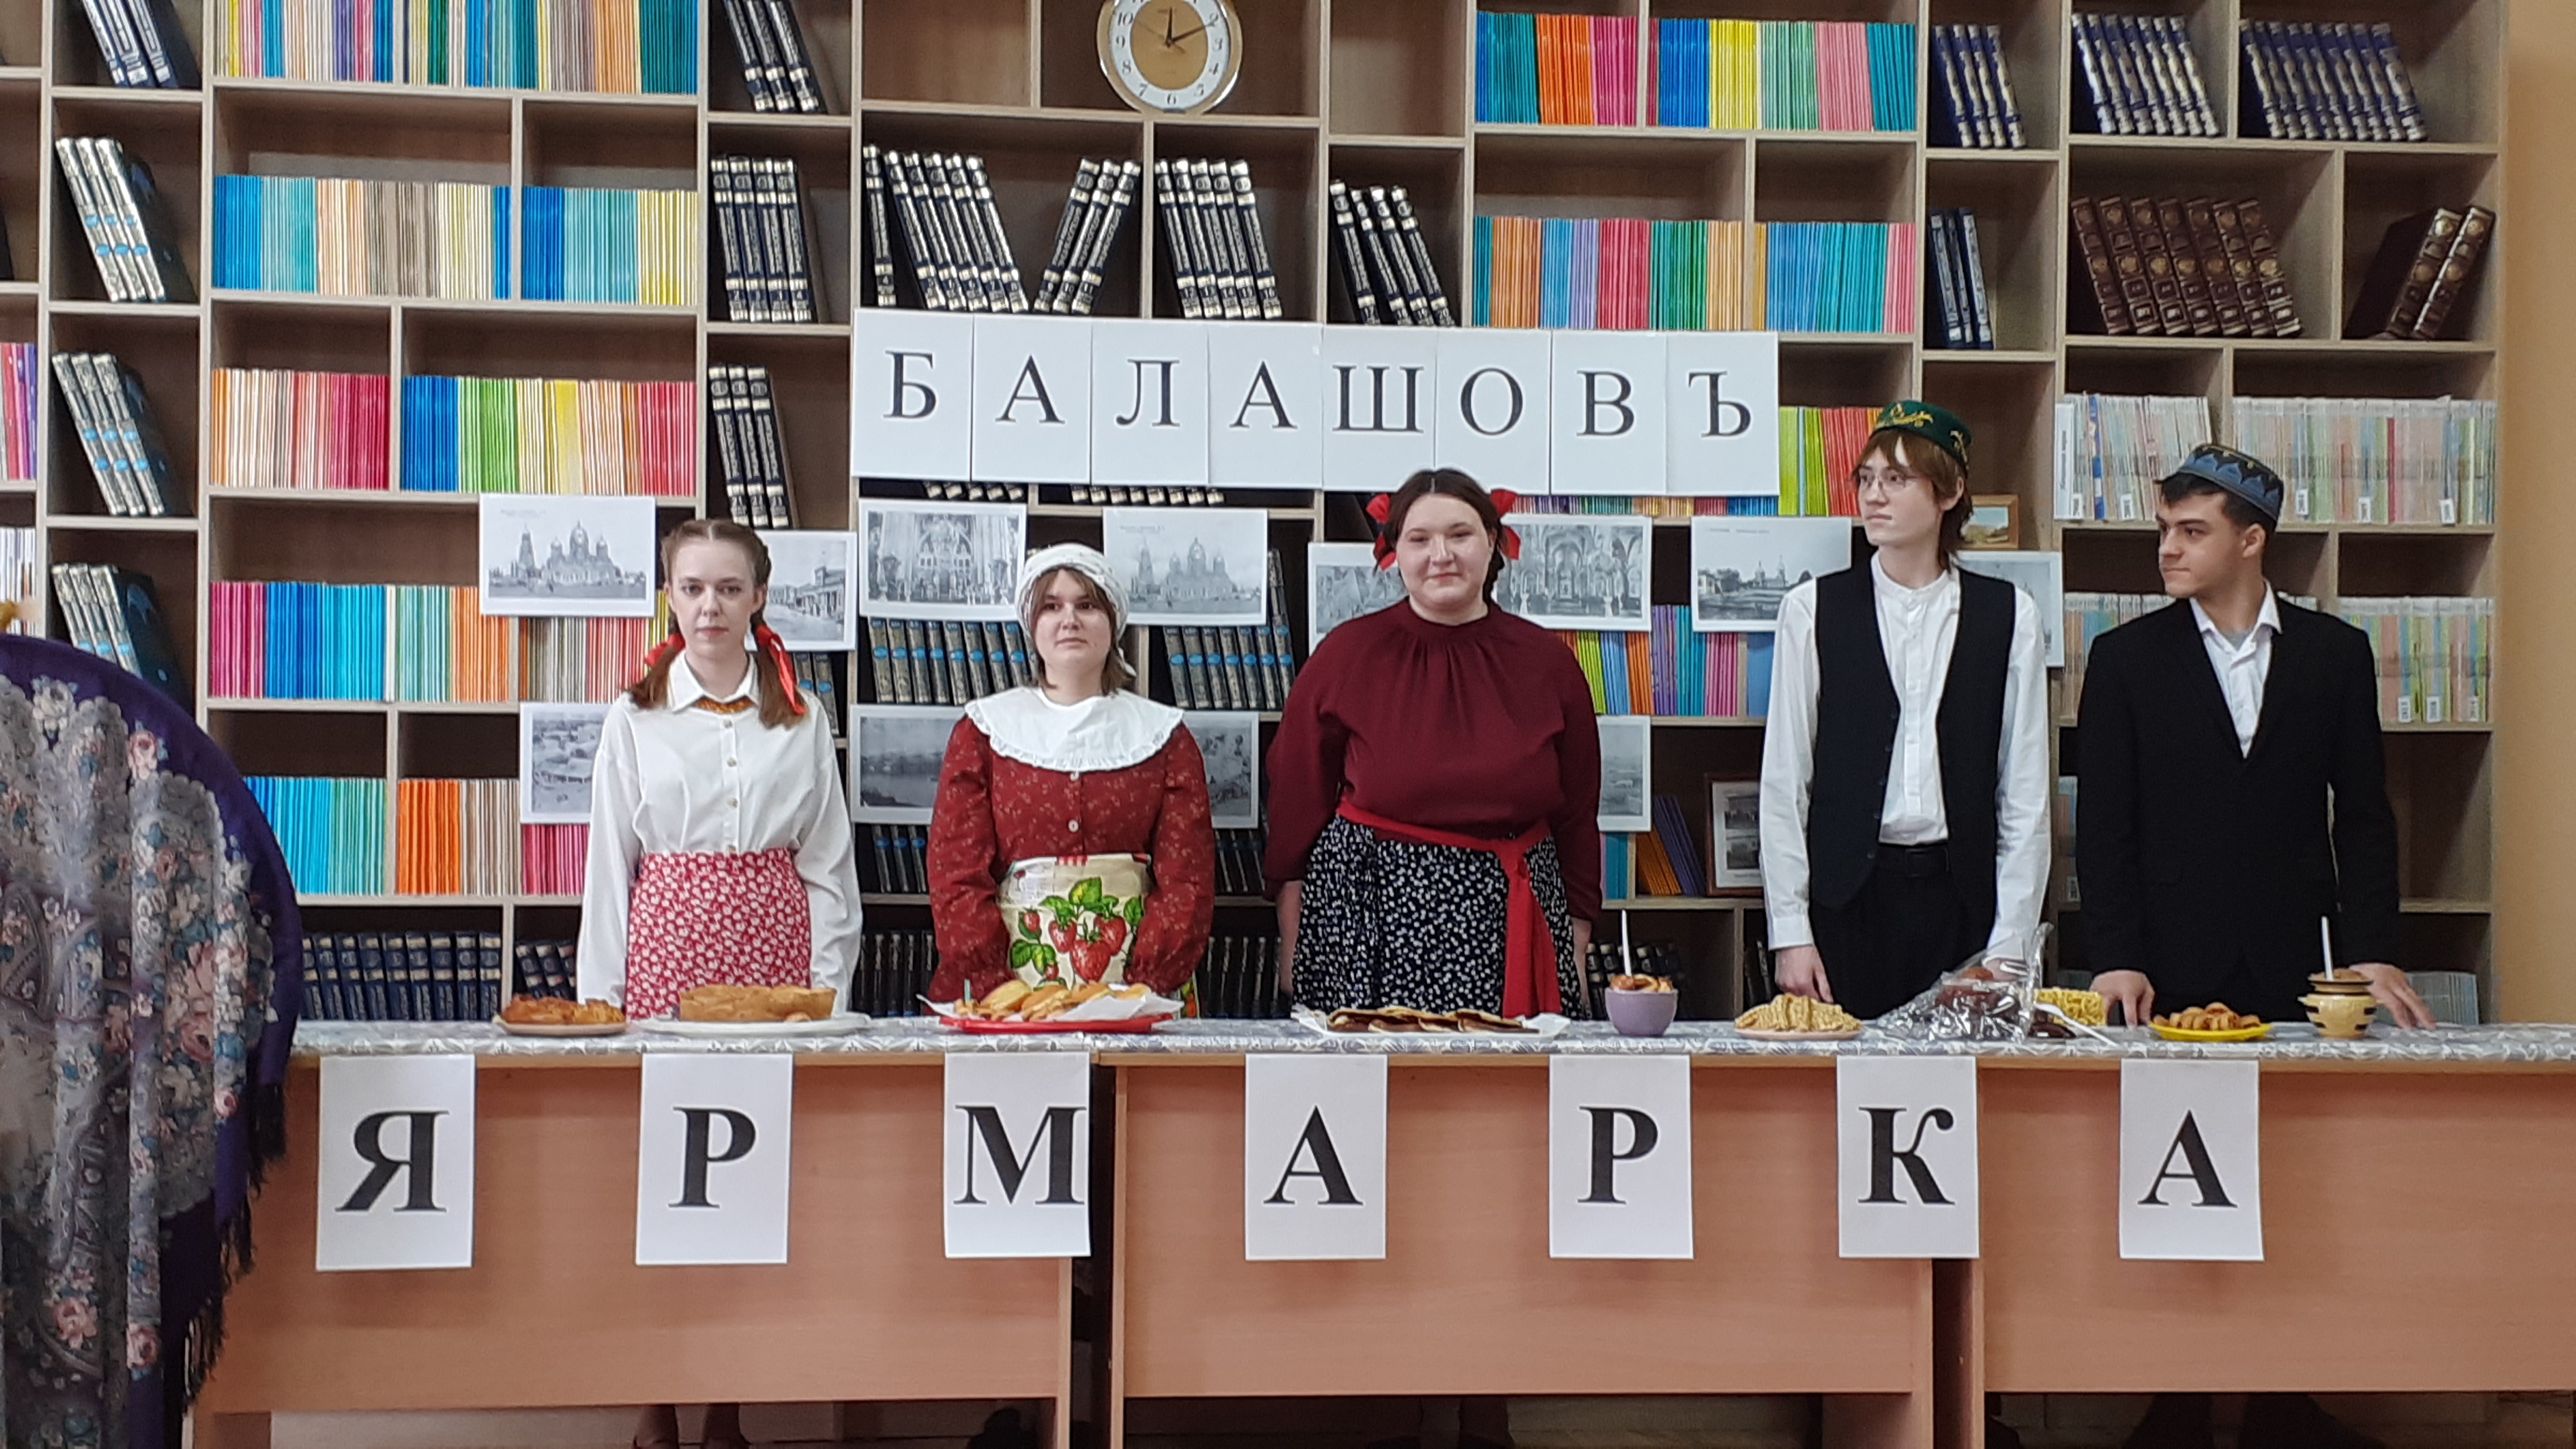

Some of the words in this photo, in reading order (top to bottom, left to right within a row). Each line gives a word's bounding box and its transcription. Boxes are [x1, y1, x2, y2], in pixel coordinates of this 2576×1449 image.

[1117, 11, 1133, 26] 10
[1115, 35, 1125, 48] 9
[1121, 59, 1131, 74] 8
[1208, 62, 1219, 76] 4
[1139, 82, 1148, 97] 7
[1167, 93, 1176, 105] 6
[885, 351, 1751, 437] БАЛАШОВЪ
[335, 1106, 2237, 1212] ЯРМАРКА
